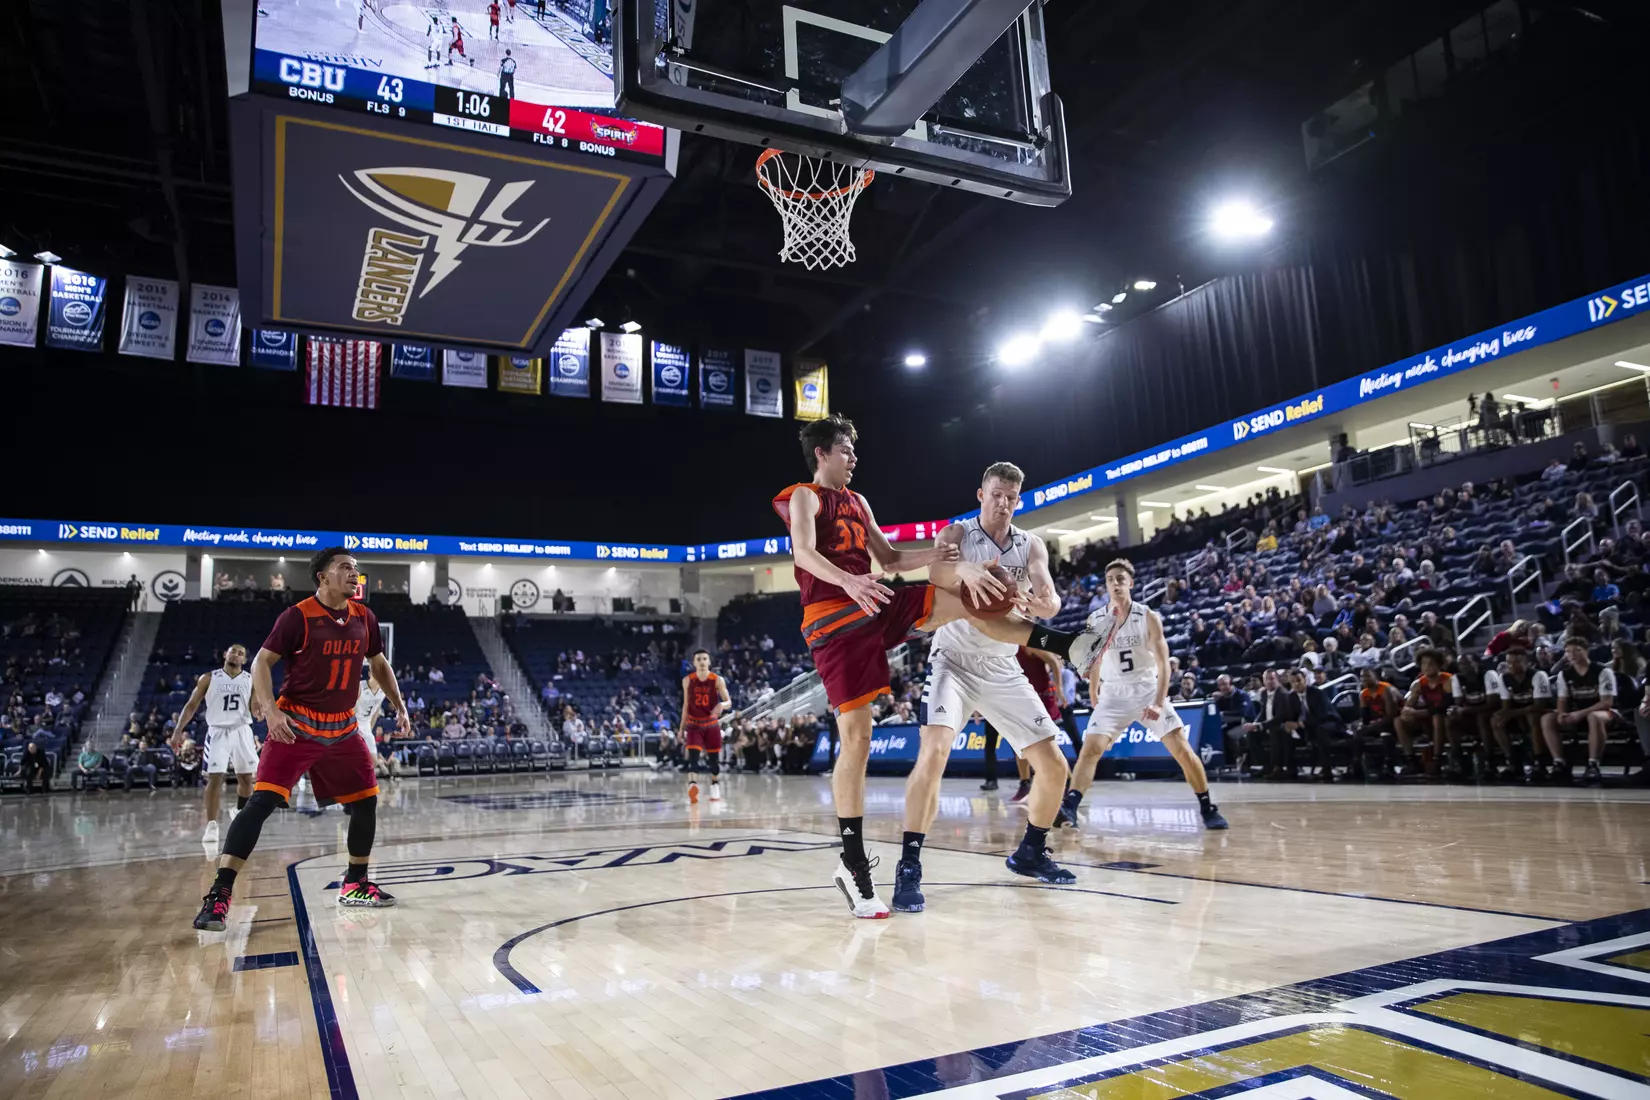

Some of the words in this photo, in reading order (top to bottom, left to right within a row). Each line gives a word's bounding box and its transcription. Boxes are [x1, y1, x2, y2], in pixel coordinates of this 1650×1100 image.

[279, 57, 347, 92] CBU
[288, 86, 334, 104] BONUS
[377, 75, 404, 102] 43
[366, 100, 390, 114] FLS
[398, 106, 406, 117] 9
[456, 91, 491, 117] 1:06
[447, 116, 468, 128] 1ST
[474, 120, 502, 133] HALF
[542, 108, 567, 134] 42
[596, 126, 633, 143] SPIRIT
[533, 132, 554, 145] FLS
[561, 138, 569, 148] 8
[580, 142, 616, 157] BONUS
[62, 274, 97, 287] 2016
[352, 227, 430, 326] LANCERS
[64, 284, 92, 294] MEN'S
[137, 282, 167, 295] 2015
[202, 291, 231, 302] 2014
[1621, 282, 1650, 309] SE
[138, 294, 163, 303] MEN'S
[1502, 324, 1538, 348] lives
[1250, 409, 1284, 434] SEND
[1285, 394, 1323, 422] Relief
[1171, 447, 1181, 459] to
[1045, 483, 1068, 502] SEND
[1067, 473, 1093, 493] Relief
[80, 526, 118, 539] SEND
[121, 527, 160, 540] Relief
[361, 537, 393, 549] SEND
[395, 538, 428, 551] Relief
[459, 542, 477, 552] Text
[478, 543, 502, 552] SEND
[535, 545, 544, 554] to
[611, 546, 639, 558] SEND
[640, 547, 668, 559] Relief
[718, 542, 747, 559] CBU
[764, 538, 778, 554] 43
[322, 639, 361, 655] OUAZ
[1119, 649, 1134, 673] 5
[326, 658, 353, 691] 11
[222, 693, 241, 712] 15
[695, 693, 709, 707] 20
[1128, 727, 1144, 743] to
